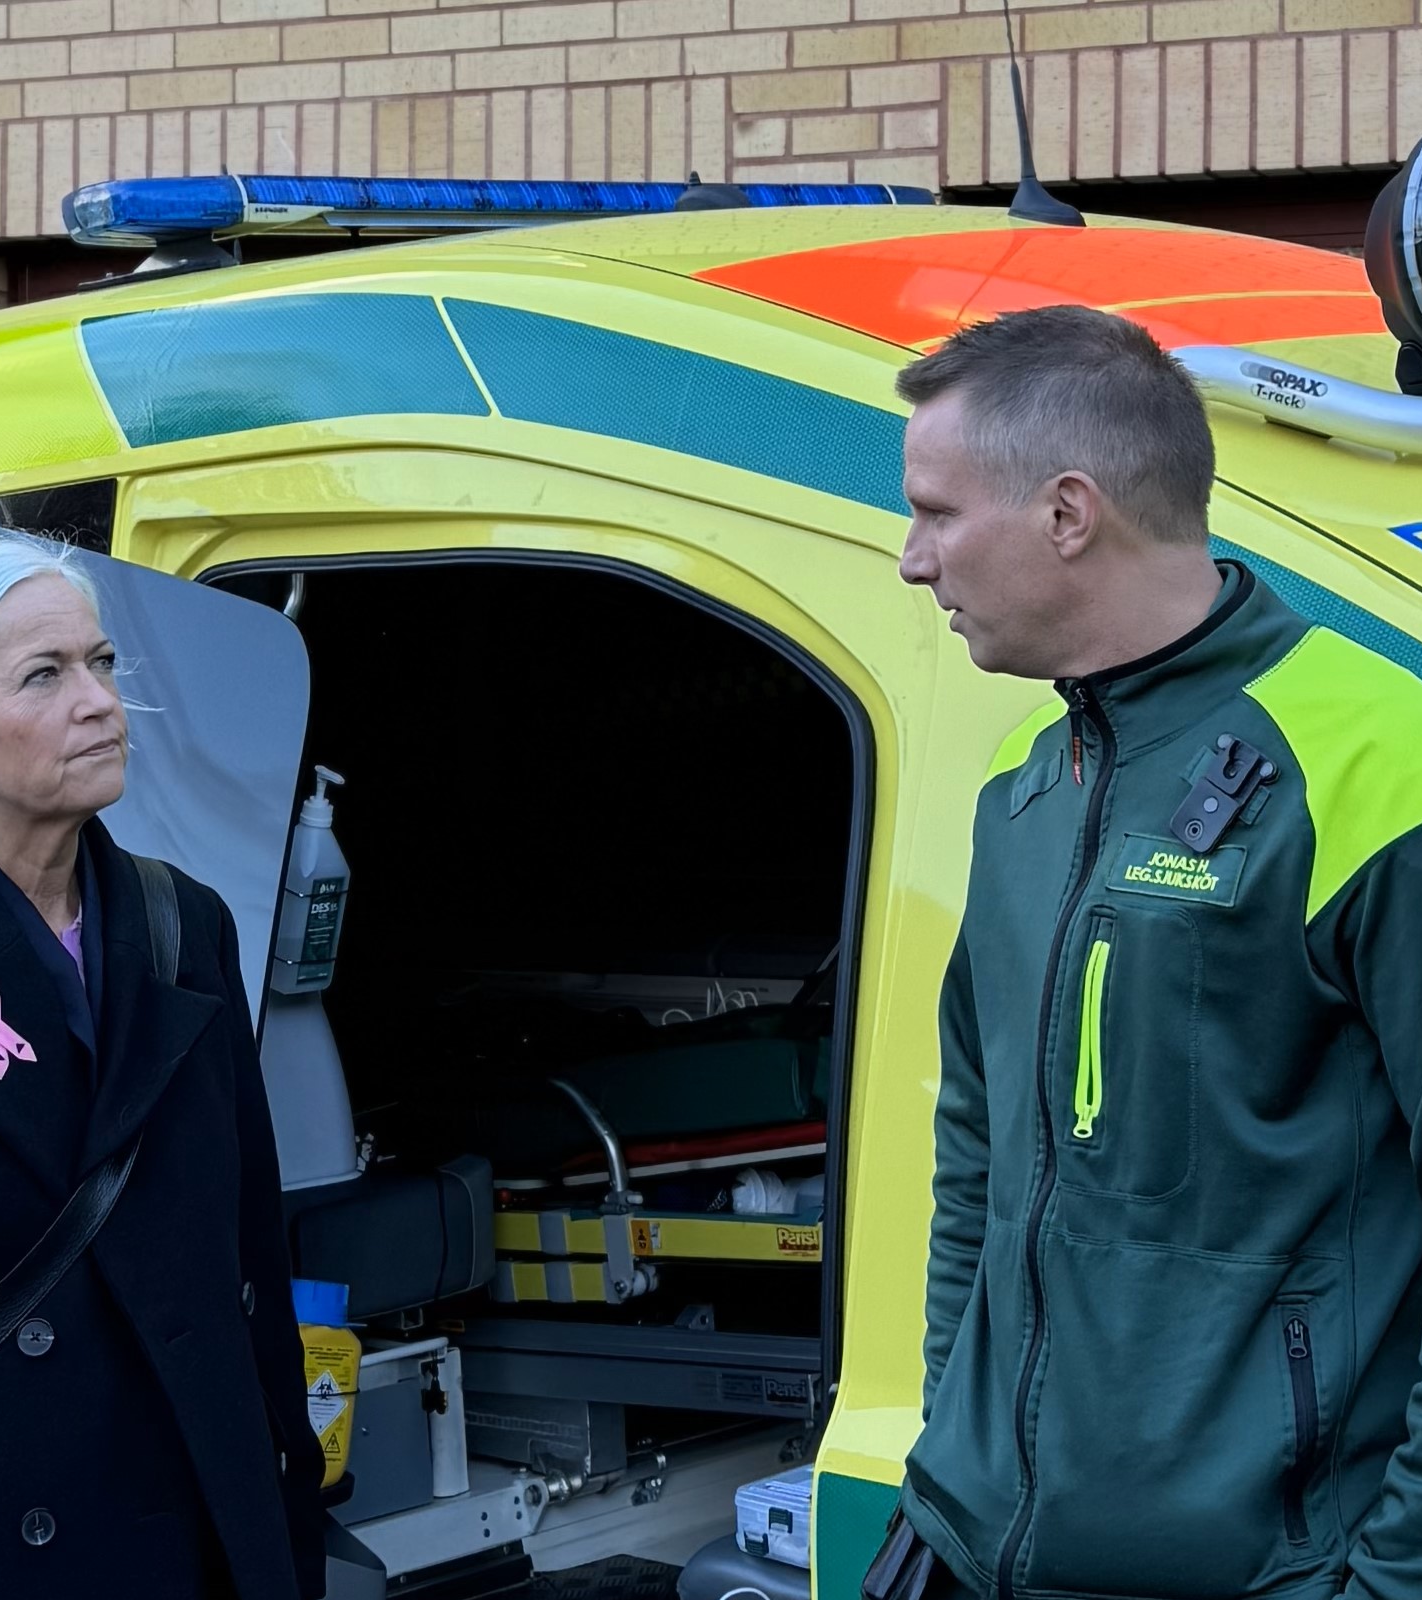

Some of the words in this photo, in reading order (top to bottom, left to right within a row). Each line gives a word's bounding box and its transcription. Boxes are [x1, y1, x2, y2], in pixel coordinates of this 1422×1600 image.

[1256, 383, 1301, 409] T-rack
[1270, 368, 1322, 398] QPAX
[1147, 851, 1197, 872] JONAS
[1196, 859, 1210, 873] H
